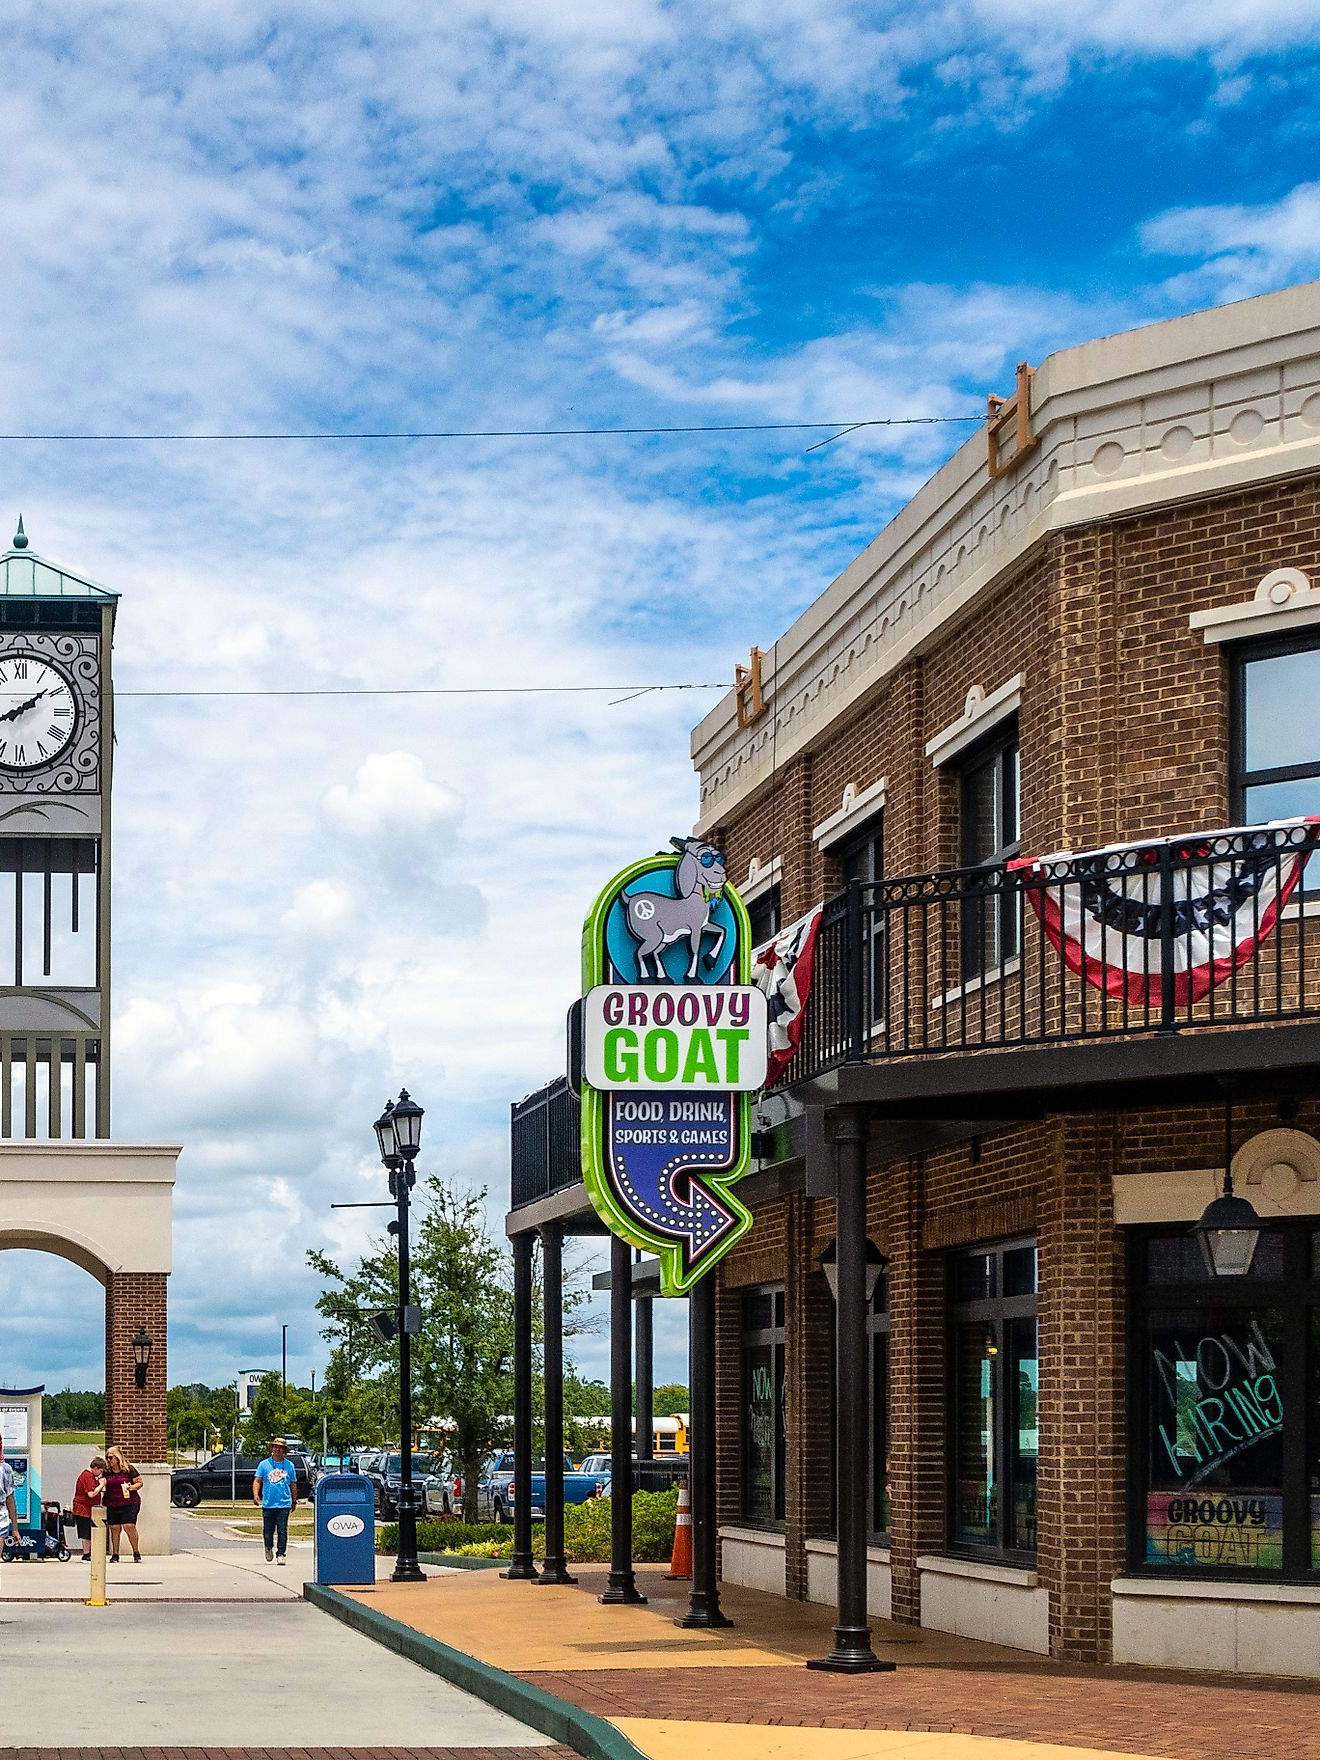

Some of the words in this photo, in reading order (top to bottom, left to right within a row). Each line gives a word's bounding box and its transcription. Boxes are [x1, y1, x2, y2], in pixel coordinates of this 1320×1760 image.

[14, 663, 27, 679] XII
[603, 992, 751, 1027] GROOVY
[603, 1028, 750, 1083] GOAT
[615, 1101, 665, 1123] FOOD,
[668, 1101, 727, 1125] DRINK,
[615, 1129, 667, 1145] SPORTS
[670, 1130, 679, 1144] &
[681, 1129, 728, 1145] GAMES
[1154, 1319, 1277, 1407] NOW
[1166, 1499, 1265, 1525] GROOVY
[333, 1522, 358, 1530] OWA
[1167, 1524, 1266, 1564] GOAT
